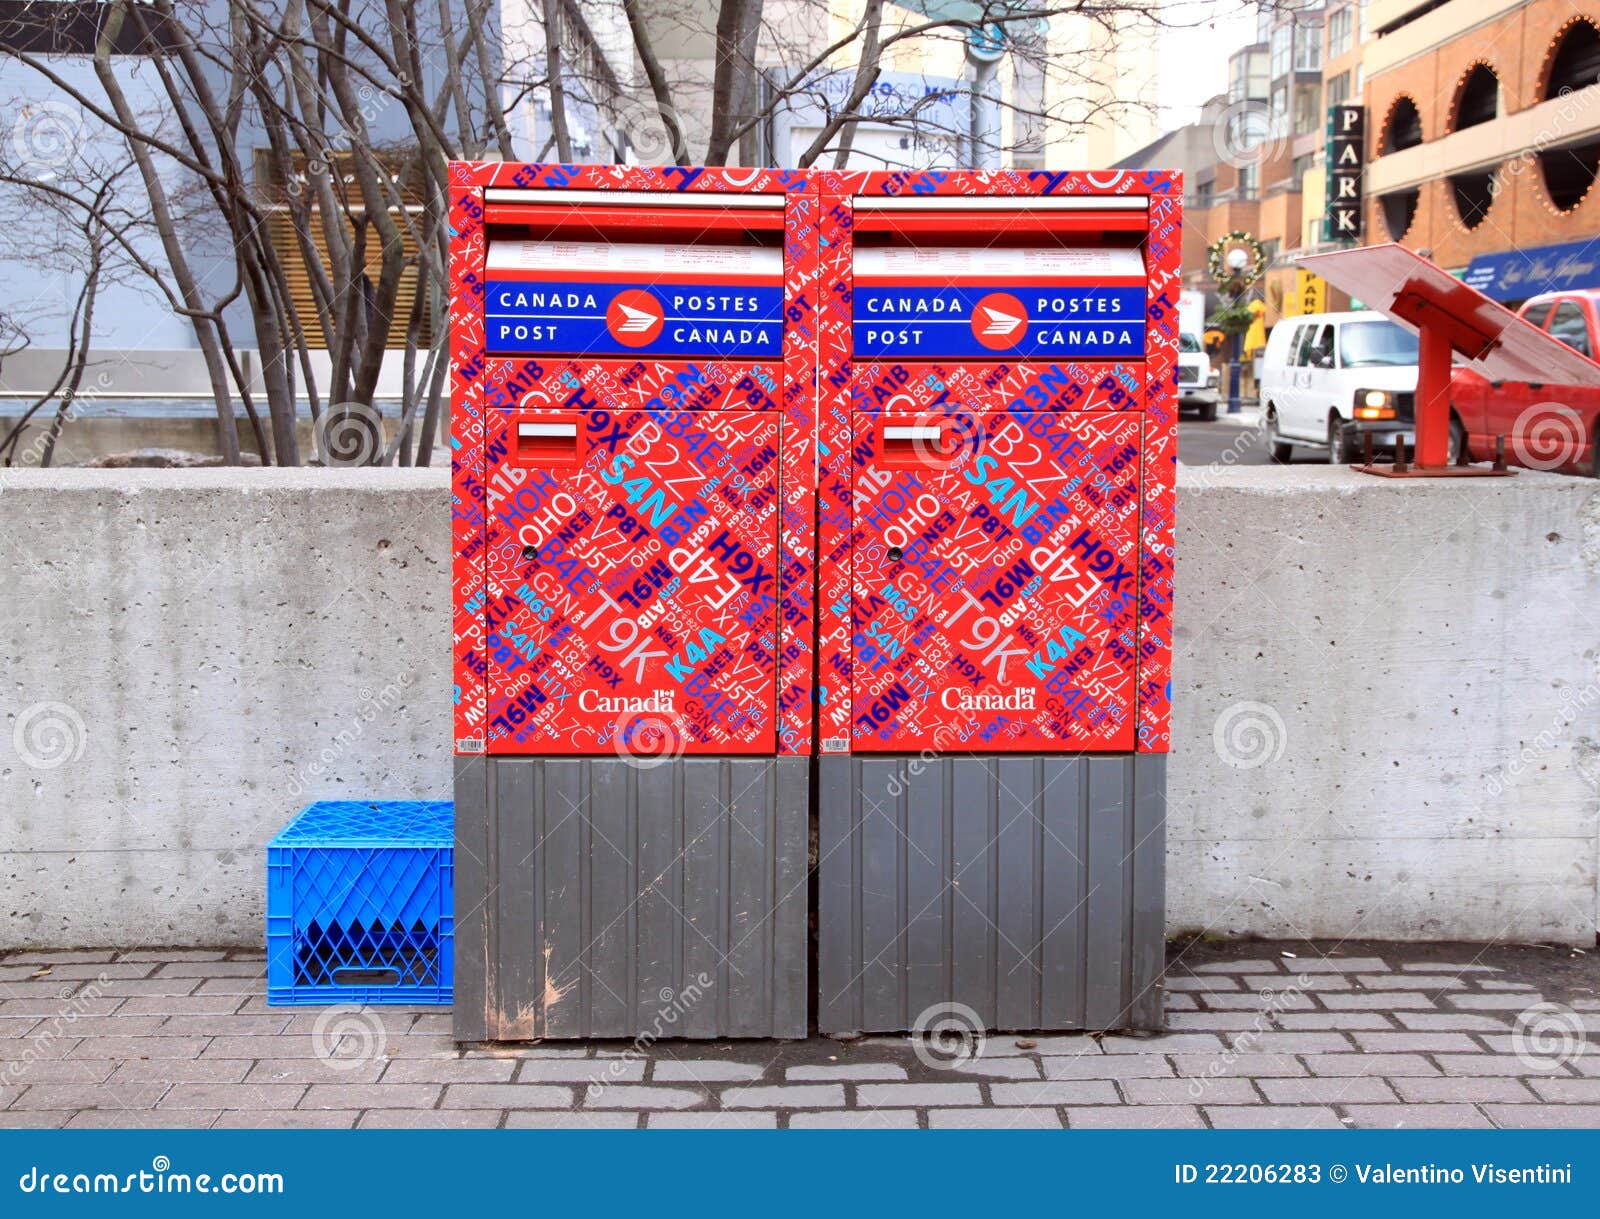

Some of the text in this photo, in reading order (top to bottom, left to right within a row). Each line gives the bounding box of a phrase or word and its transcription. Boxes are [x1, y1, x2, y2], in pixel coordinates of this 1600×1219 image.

[1338, 110, 1359, 231] PARK
[500, 292, 597, 309] CANADA
[674, 295, 758, 312] POSTES
[867, 298, 962, 313] CANADA
[1037, 298, 1121, 313] POSTES
[500, 325, 557, 340] POST
[673, 328, 769, 344] CANADA
[867, 330, 923, 345] POST
[1037, 330, 1132, 345] CANADA
[505, 360, 544, 400] A1B
[597, 372, 627, 402] B2Z
[630, 363, 674, 402] X1A
[735, 377, 776, 414] P8T
[872, 364, 909, 404] A1B
[994, 365, 1037, 403] X1A
[1008, 364, 1070, 425] B3N
[564, 388, 630, 453] H9X
[708, 420, 745, 449] J5T
[1028, 412, 1085, 469] B4E
[1069, 419, 1106, 448] J5T
[626, 421, 706, 501] B2Z
[989, 422, 1068, 501] B2Z
[600, 453, 678, 528] S4N
[934, 470, 972, 509] X1A
[964, 454, 1040, 528] S4N
[607, 504, 650, 543] P8T
[659, 498, 708, 546] B3N
[970, 504, 1012, 543] P8T
[1021, 498, 1069, 545] B3N
[538, 538, 595, 596] B4E
[579, 546, 616, 576] J5T
[668, 546, 742, 610] E4P
[708, 530, 773, 594] H9X
[902, 539, 959, 596] B4E
[943, 547, 979, 576] J5T
[1030, 545, 1102, 608] E4P
[1069, 529, 1133, 592] H9X
[514, 583, 554, 621] M6S
[534, 572, 579, 616] G3N
[618, 559, 674, 608] M9L
[879, 584, 918, 621] M6S
[898, 572, 943, 616] G3N
[980, 559, 1035, 607] M9L
[499, 621, 542, 661] S4N
[580, 588, 670, 685] T9K
[712, 608, 750, 649] X1A
[864, 621, 906, 660] S4N
[943, 588, 1031, 683] T9K
[1073, 606, 1110, 646] X1A
[664, 627, 727, 683] K4A
[746, 641, 774, 668] P8T
[950, 654, 985, 687] H9X
[1025, 625, 1086, 680] K4A
[1105, 638, 1133, 664] P8T
[537, 670, 573, 707] H1X
[588, 655, 623, 689] H9X
[901, 668, 936, 705] H1X
[1082, 677, 1114, 703] J5T
[492, 683, 548, 732] M9L
[579, 689, 675, 712] Canada
[684, 673, 736, 723] B4E
[722, 680, 755, 706] J5T
[857, 682, 911, 730] M9L
[942, 687, 1035, 710] Canada
[1044, 670, 1095, 720] B4E
